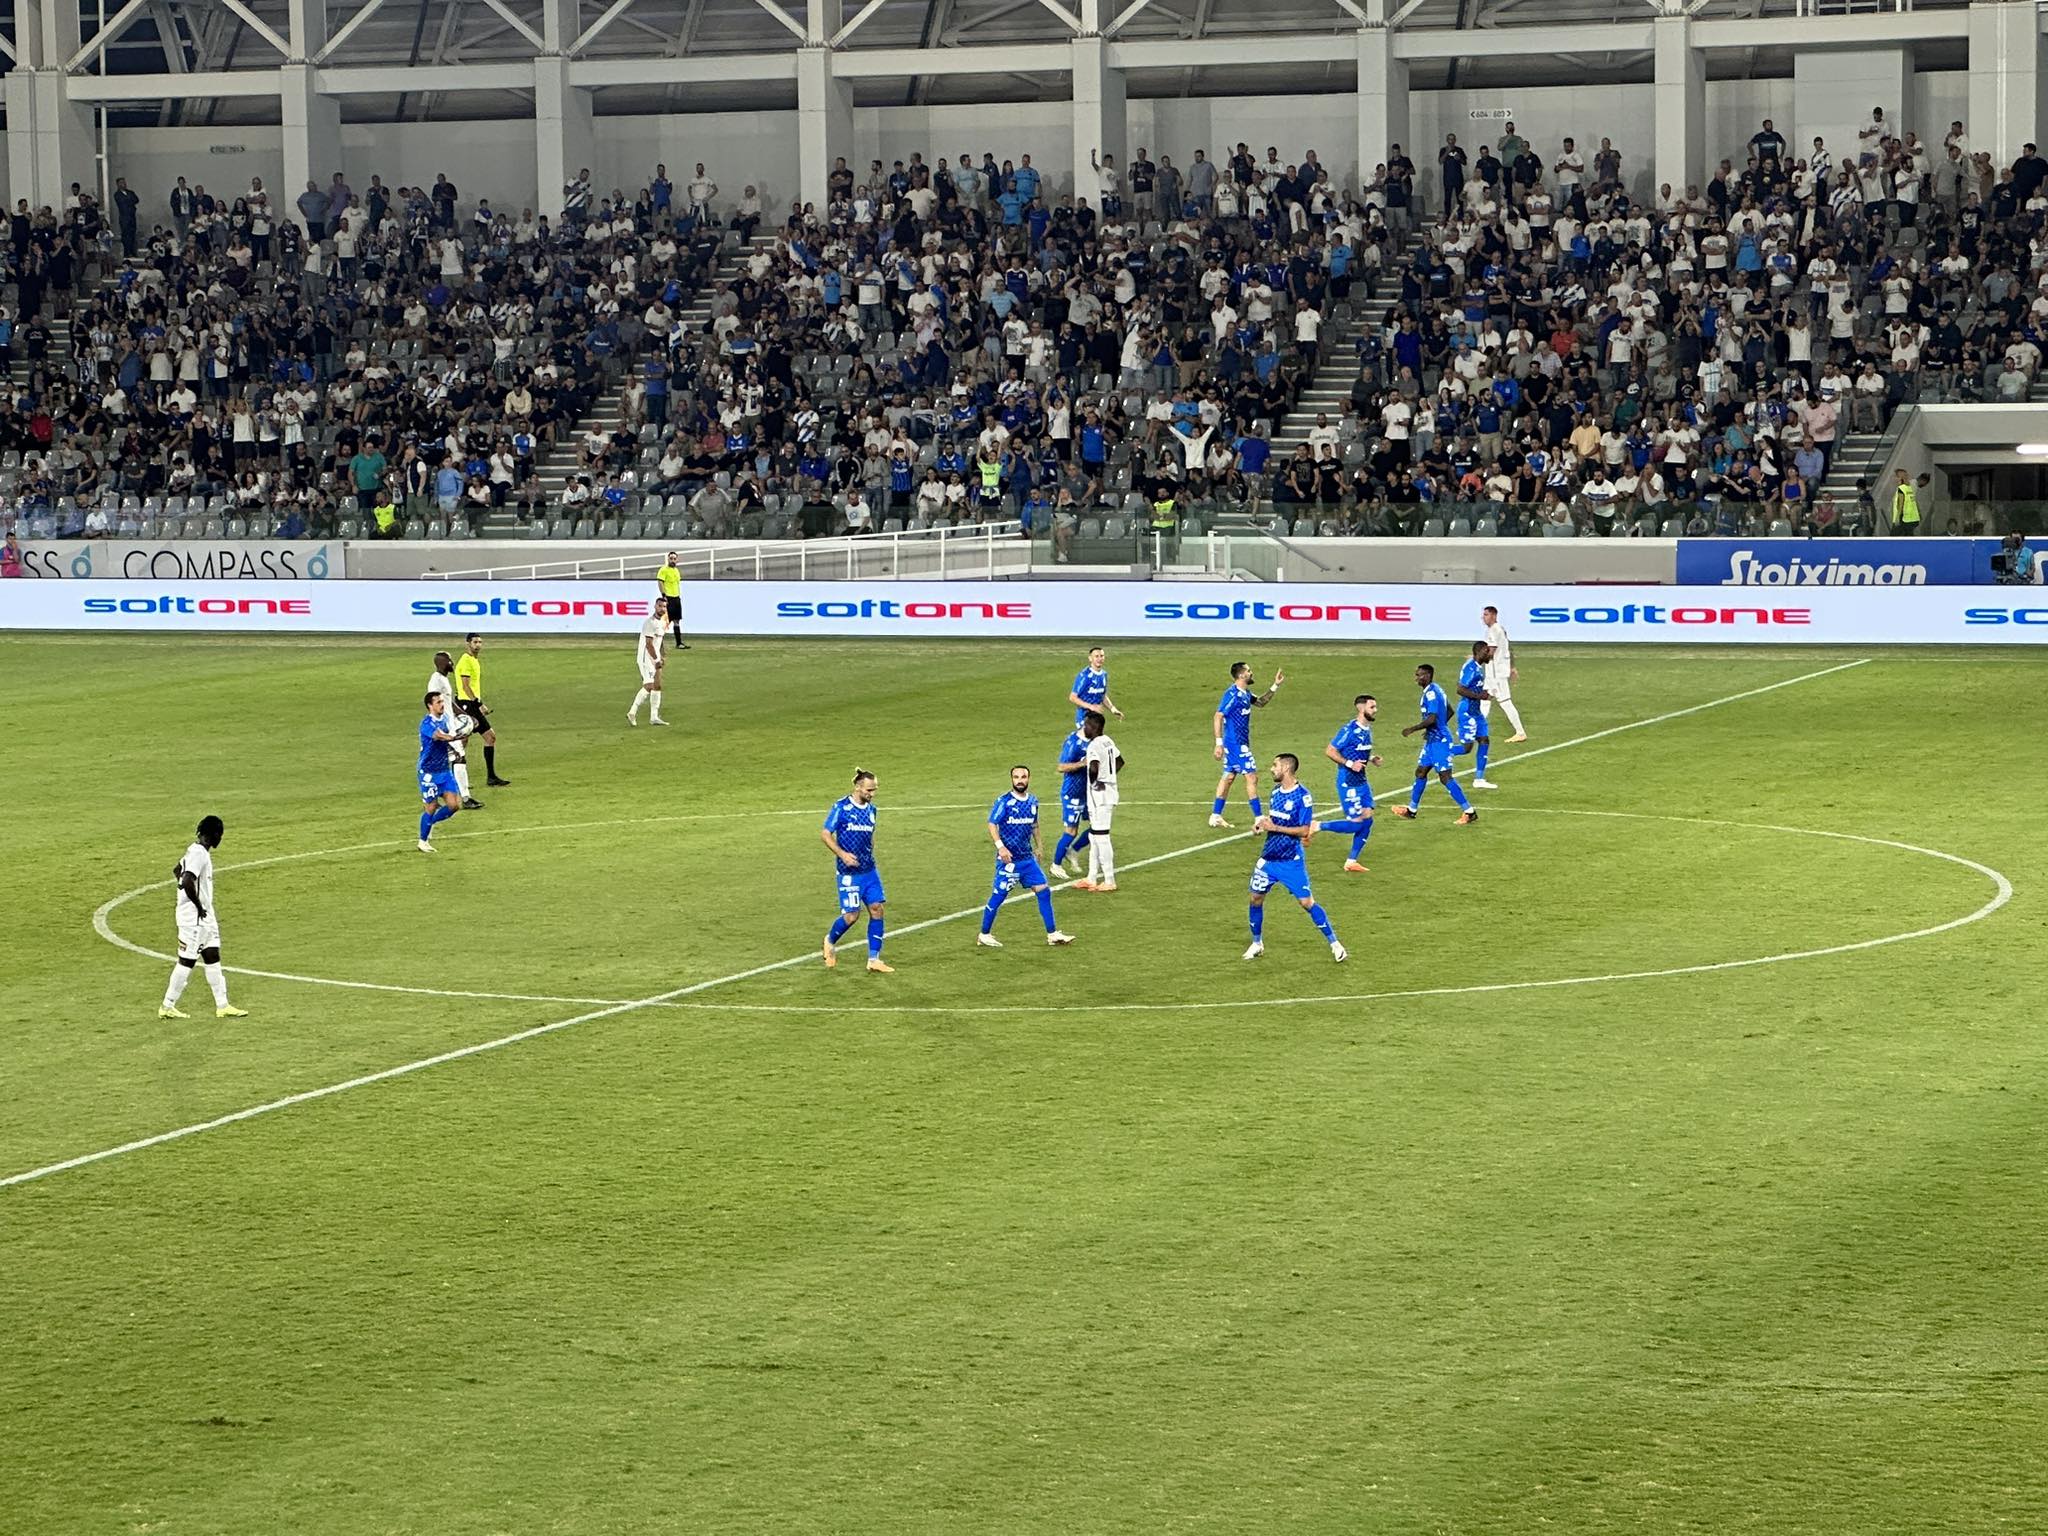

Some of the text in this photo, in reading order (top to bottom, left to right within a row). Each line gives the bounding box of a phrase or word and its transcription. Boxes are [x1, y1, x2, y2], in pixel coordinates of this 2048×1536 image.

[123, 550, 298, 578] COMPASS
[1721, 550, 1927, 585] Stoiximan
[848, 891, 860, 908] 10
